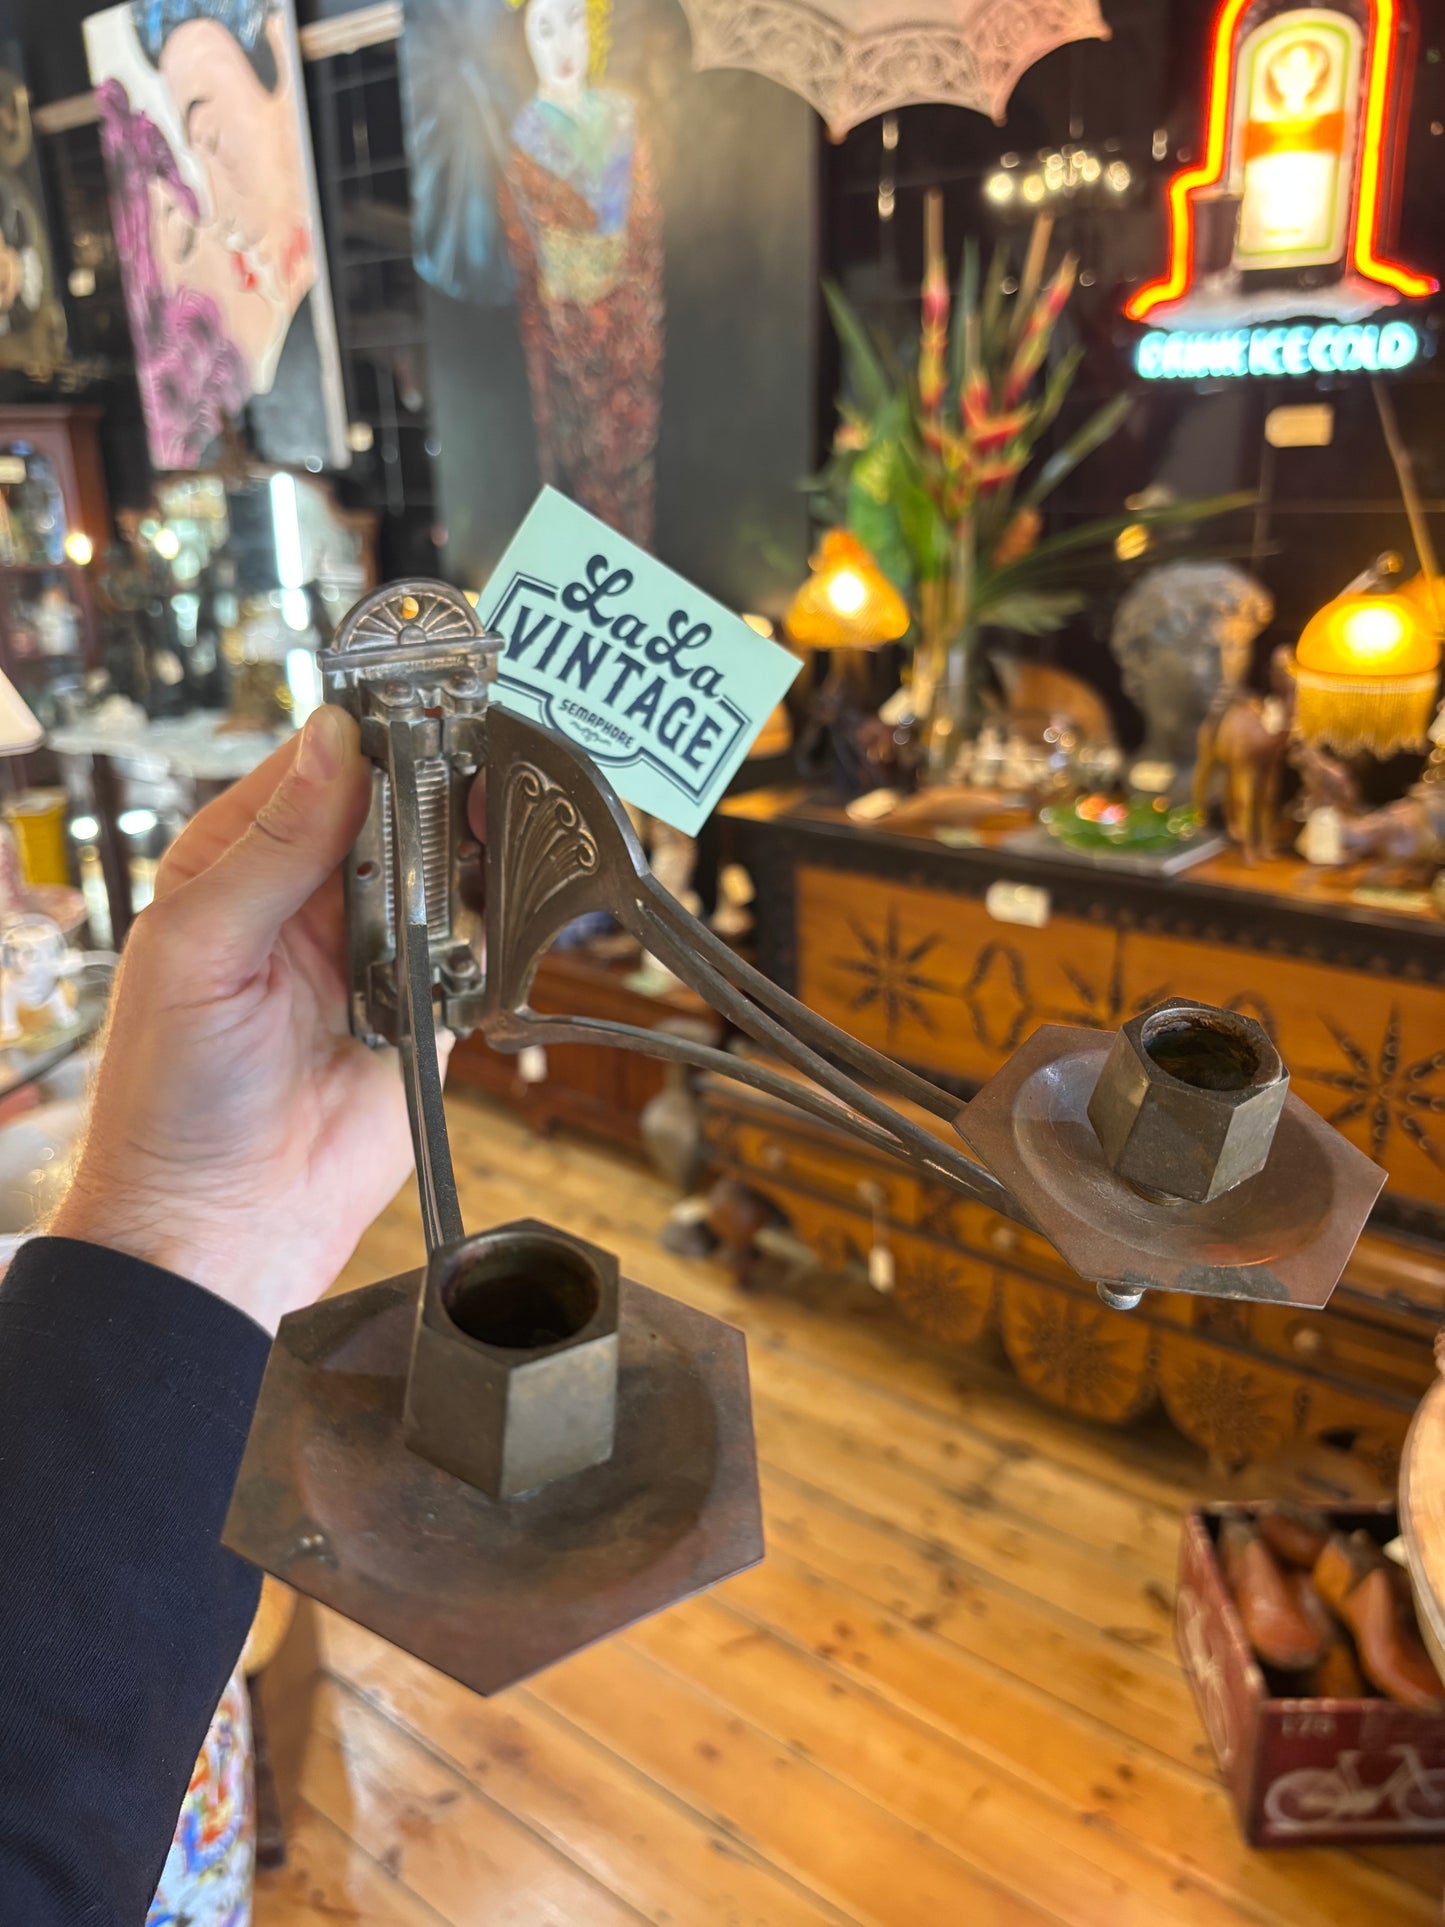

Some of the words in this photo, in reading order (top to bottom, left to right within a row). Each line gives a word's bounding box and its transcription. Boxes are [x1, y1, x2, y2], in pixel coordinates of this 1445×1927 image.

[1249, 326, 1313, 375] ICE
[1308, 322, 1418, 371] COLD
[561, 554, 647, 649] La
[645, 609, 724, 697] La
[504, 605, 723, 772] VINTAGE
[557, 699, 636, 749] SEMAPHORE
